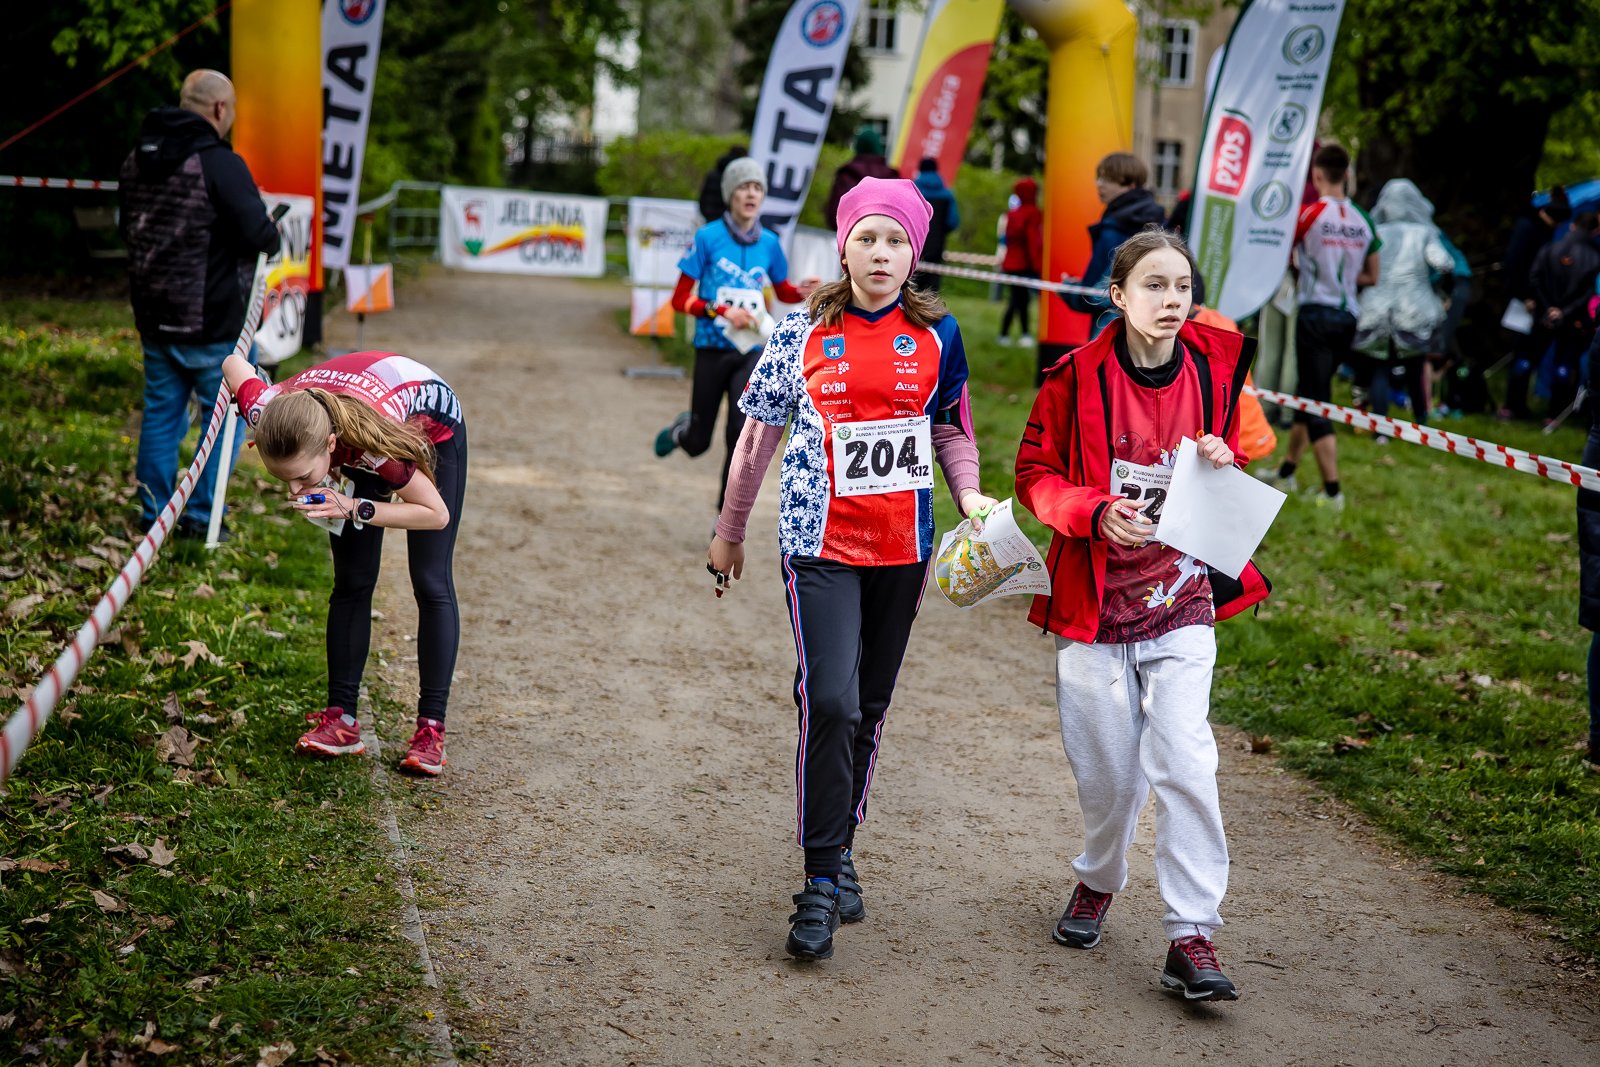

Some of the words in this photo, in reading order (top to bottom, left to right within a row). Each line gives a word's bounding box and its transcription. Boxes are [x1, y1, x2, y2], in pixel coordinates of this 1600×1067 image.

[1215, 130, 1246, 188] PZOS
[498, 199, 583, 226] JELENIA
[297, 369, 386, 399] HARPAGAN
[821, 381, 846, 395] CX80
[895, 382, 919, 391] ATLAS
[845, 435, 919, 479] 204
[911, 465, 929, 478] K12
[1133, 469, 1154, 478] KLUBOWE
